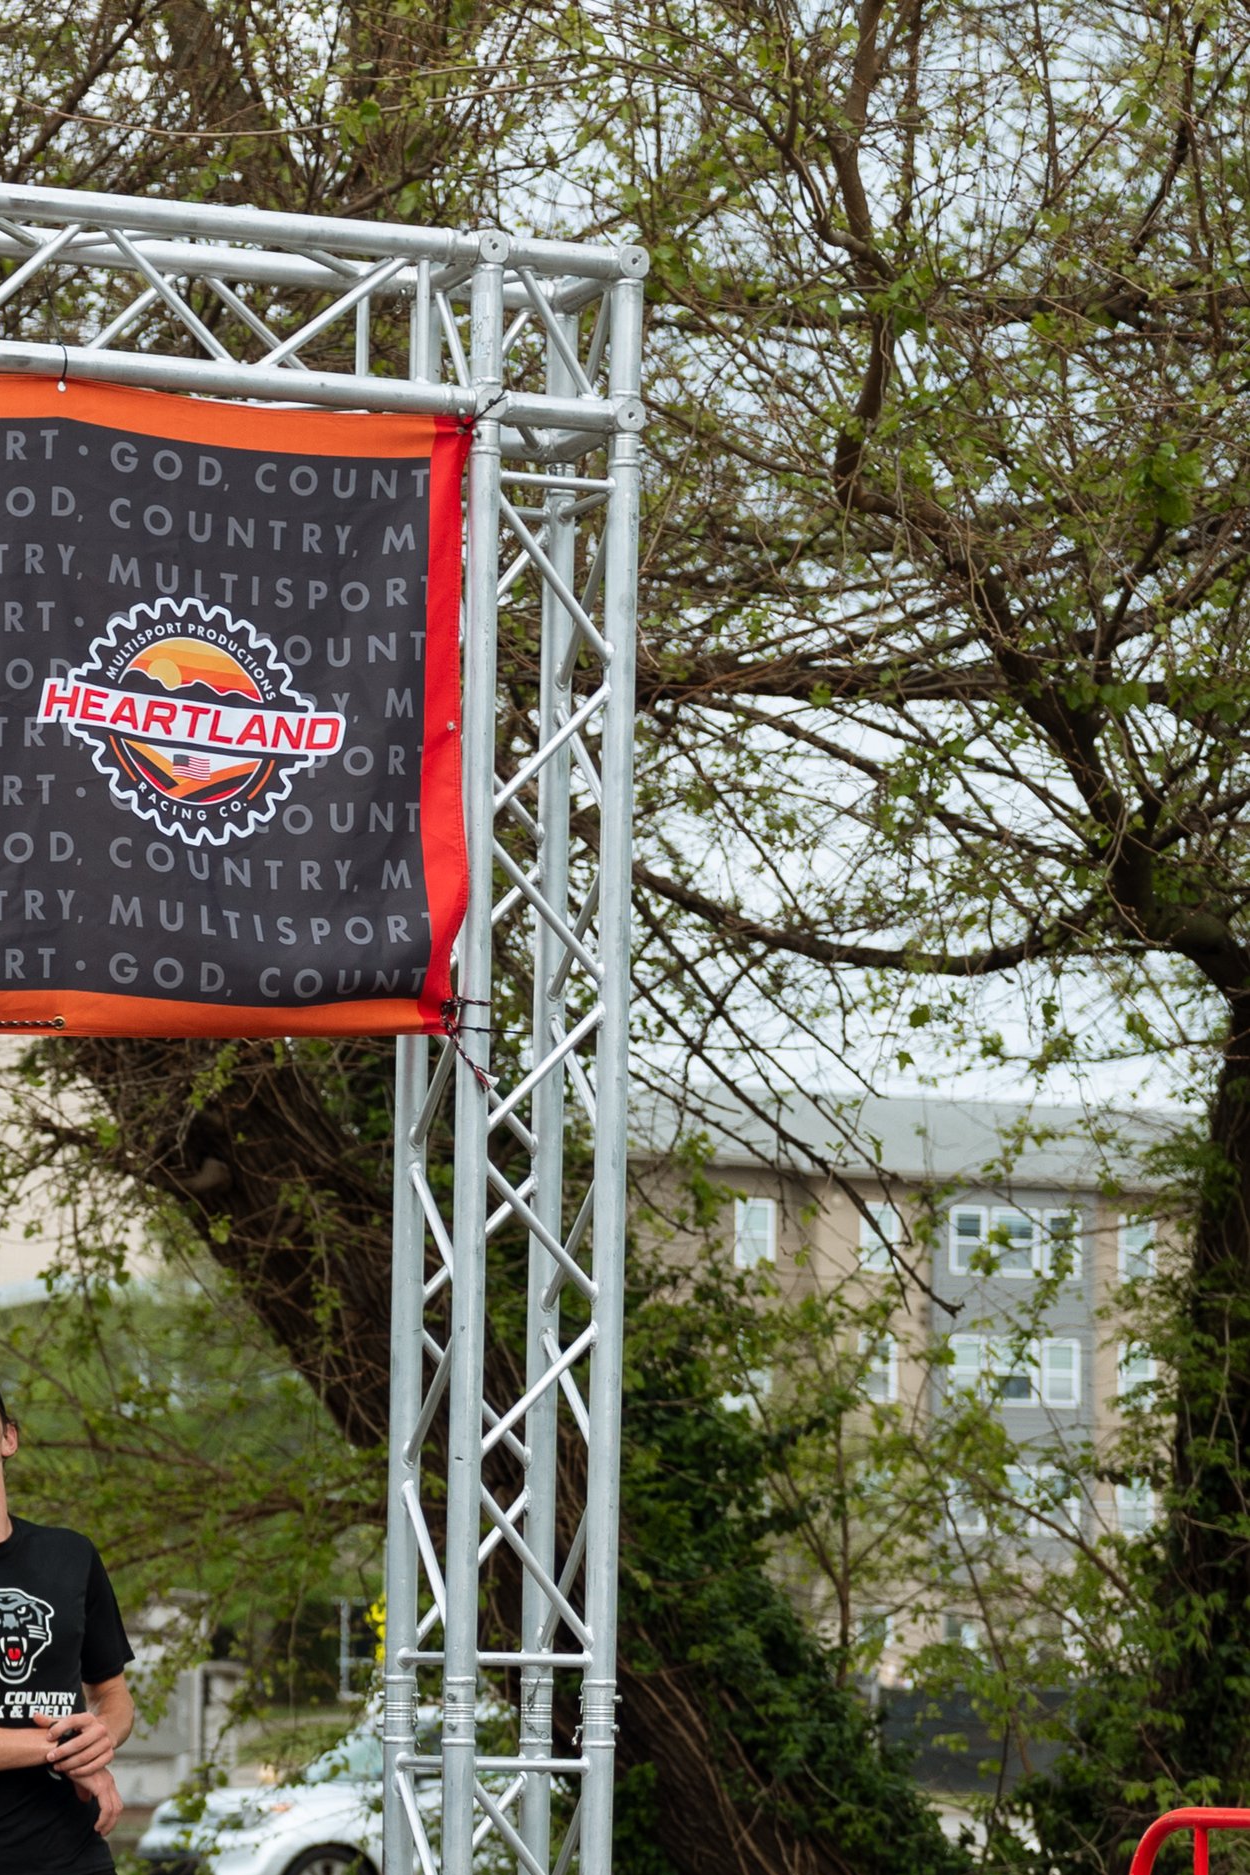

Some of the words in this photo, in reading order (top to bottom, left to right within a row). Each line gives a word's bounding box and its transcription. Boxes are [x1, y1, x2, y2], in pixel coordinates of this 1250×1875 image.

[111, 442, 231, 492] GOD,
[256, 463, 429, 498] COUNT
[110, 498, 360, 560] COUNTRY,
[107, 622, 182, 681] MULTISPORT
[187, 623, 277, 701] PRODUCTIONS
[255, 630, 425, 665] OUNT
[39, 681, 343, 752] HEARTLAND
[137, 782, 208, 821] RACING
[219, 801, 248, 818] CO.
[283, 803, 419, 834] OUNT
[110, 837, 361, 895] COUNTRY,
[110, 953, 233, 992] GOD,
[257, 966, 427, 999] COUNT
[4, 1690, 77, 1706] COUNTRY
[9, 1704, 23, 1719] &
[28, 1704, 73, 1719] FIELD
